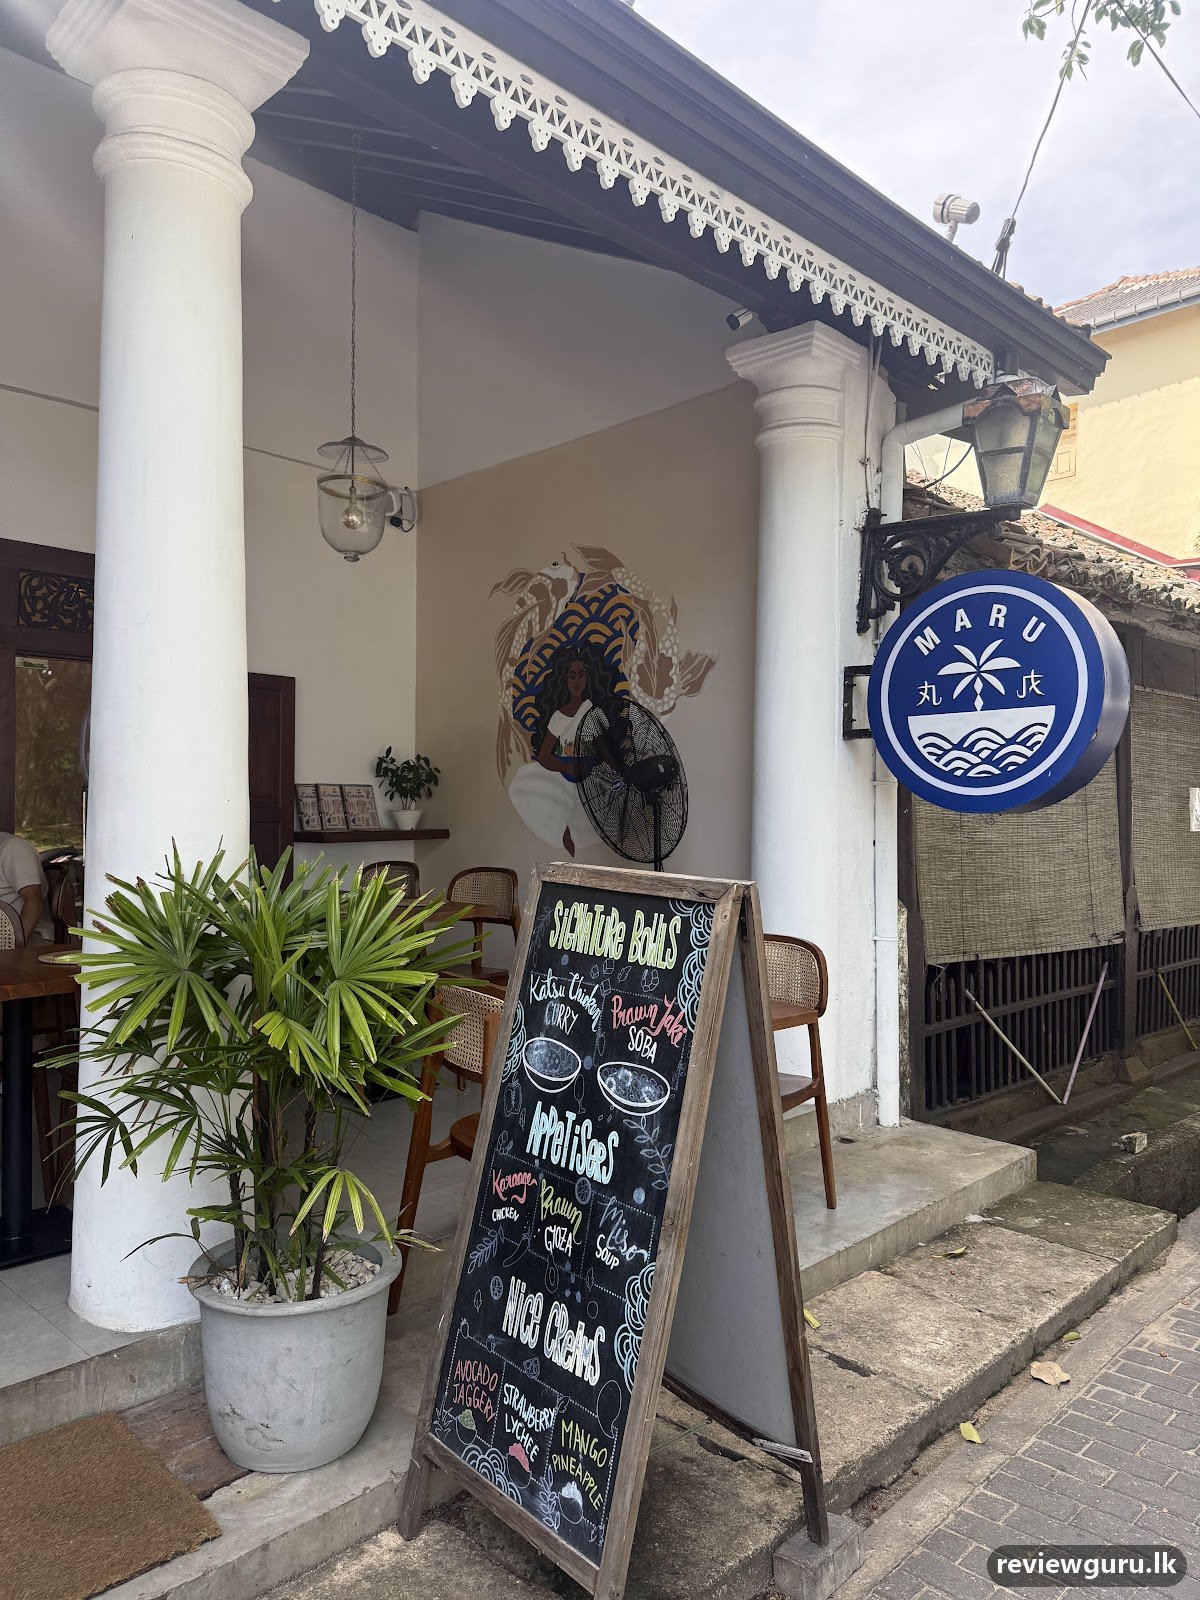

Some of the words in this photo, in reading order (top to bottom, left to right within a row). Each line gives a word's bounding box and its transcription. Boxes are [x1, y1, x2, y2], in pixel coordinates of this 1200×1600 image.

[913, 603, 1046, 656] MARU
[916, 681, 942, 706] 丸
[529, 968, 566, 1005] Katsu
[544, 1000, 580, 1036] CURRY
[610, 994, 658, 1030] Prawn
[627, 1025, 658, 1064] SOBA
[491, 1206, 520, 1222] CHICKEN
[544, 1224, 573, 1258] GYOZA
[595, 1233, 620, 1271] SOUP
[454, 1359, 499, 1392] AVOCADO
[452, 1382, 497, 1423] JAGGERY
[503, 1382, 557, 1433] STRAWBERRY
[504, 1412, 540, 1463] LYCHEE
[560, 1418, 609, 1468] MANGO
[551, 1453, 605, 1511] PINEAPPLE
